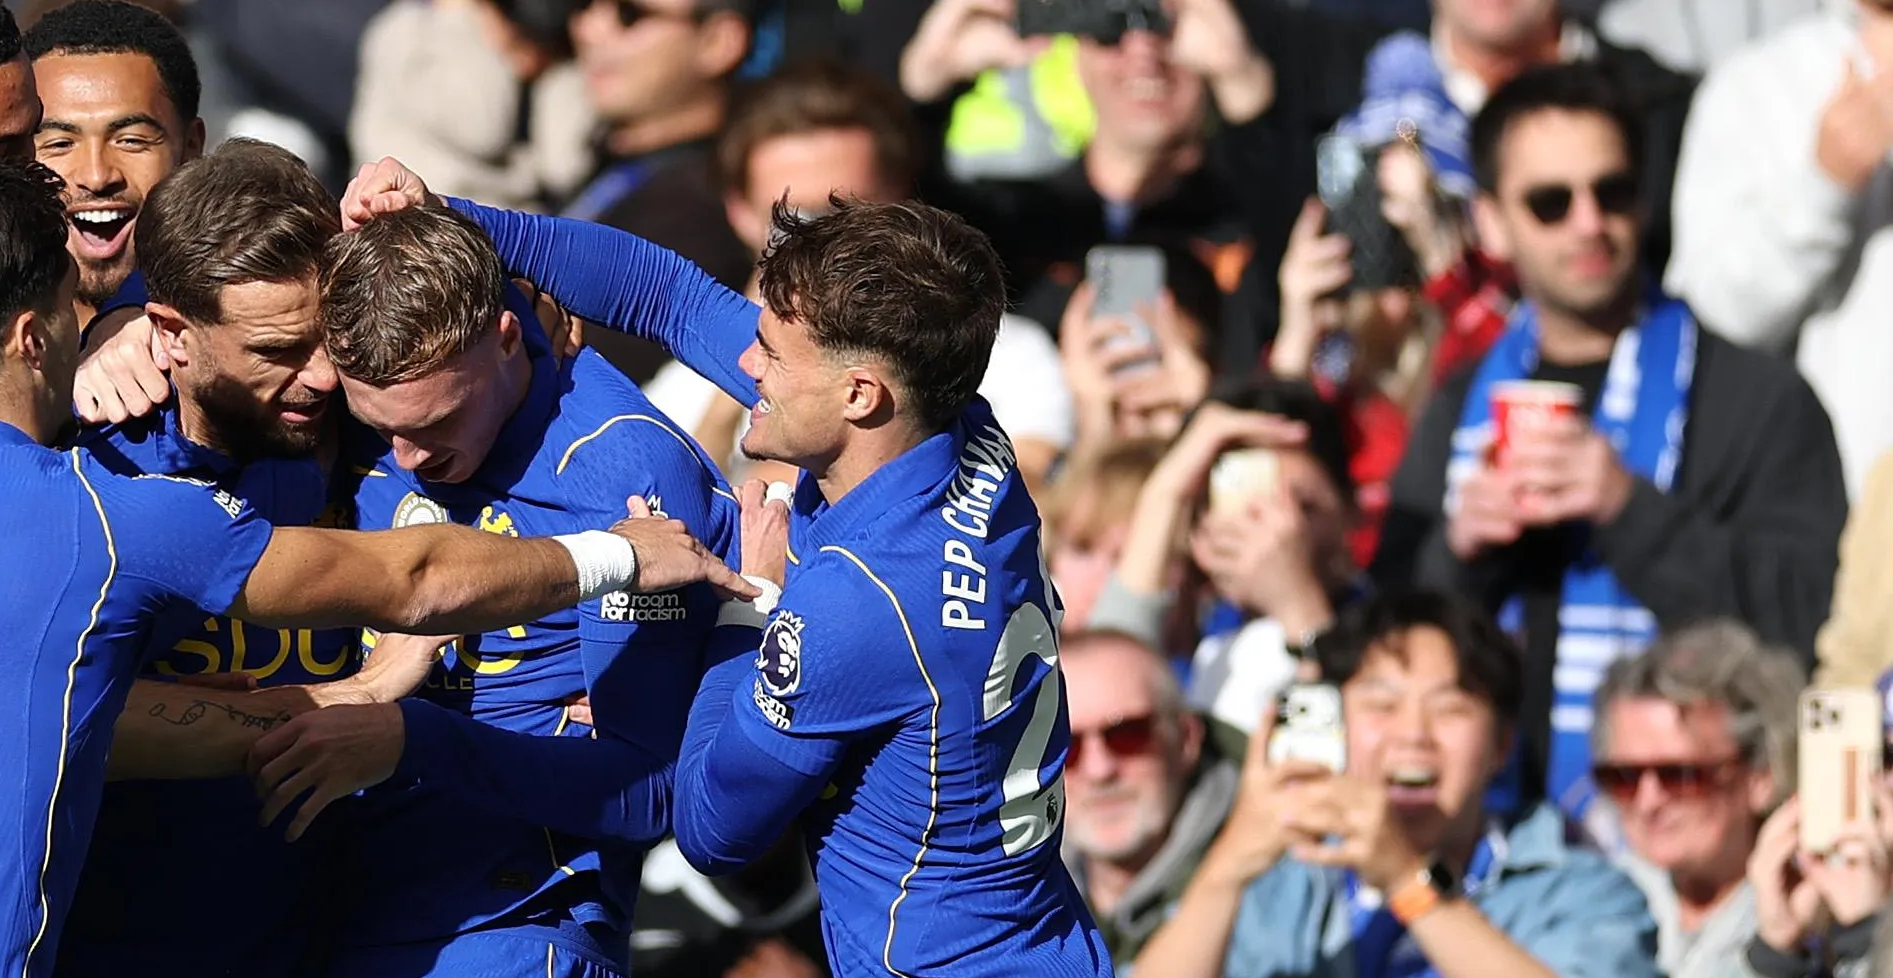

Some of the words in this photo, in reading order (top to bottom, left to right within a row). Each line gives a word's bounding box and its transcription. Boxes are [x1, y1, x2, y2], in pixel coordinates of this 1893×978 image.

[941, 539, 987, 630] PEP
[631, 594, 679, 607] room
[628, 607, 686, 621] racism
